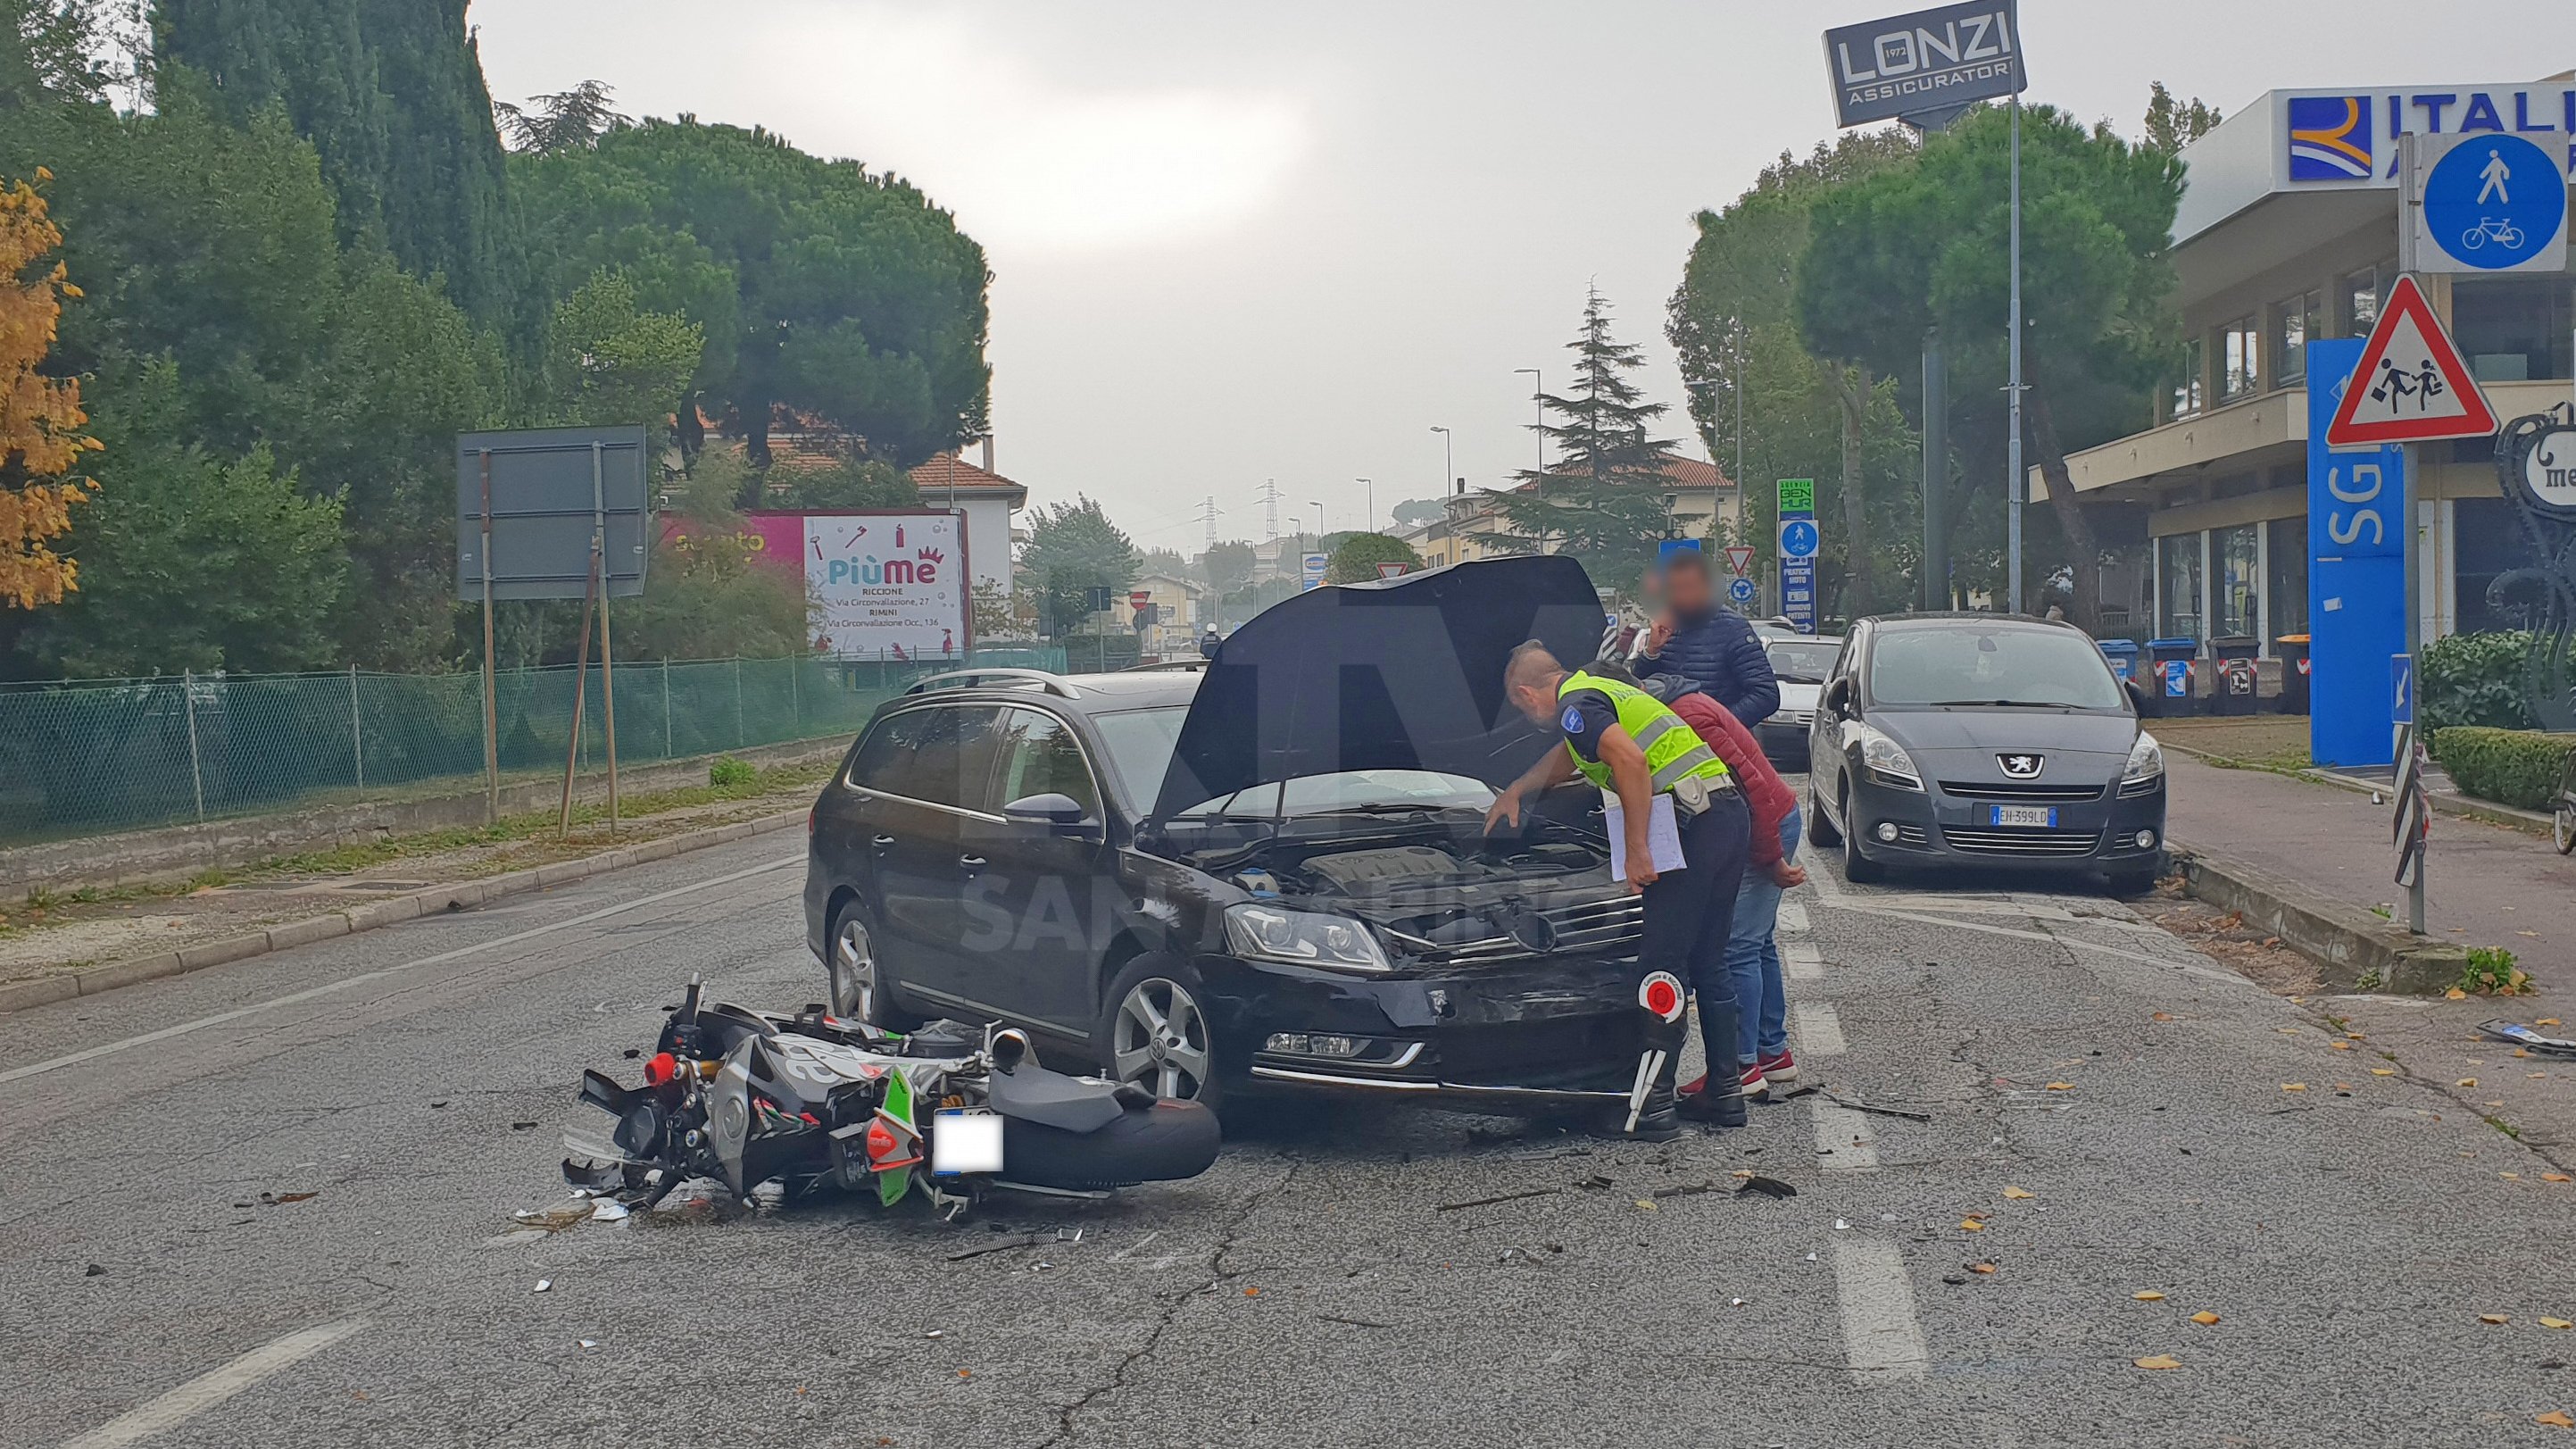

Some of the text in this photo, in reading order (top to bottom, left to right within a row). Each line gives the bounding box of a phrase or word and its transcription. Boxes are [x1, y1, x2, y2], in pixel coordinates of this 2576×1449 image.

[1838, 11, 2011, 84] LONZI
[1885, 46, 1907, 59] 1972
[842, 619, 902, 627] Circonvallazione
[925, 619, 938, 627] 136
